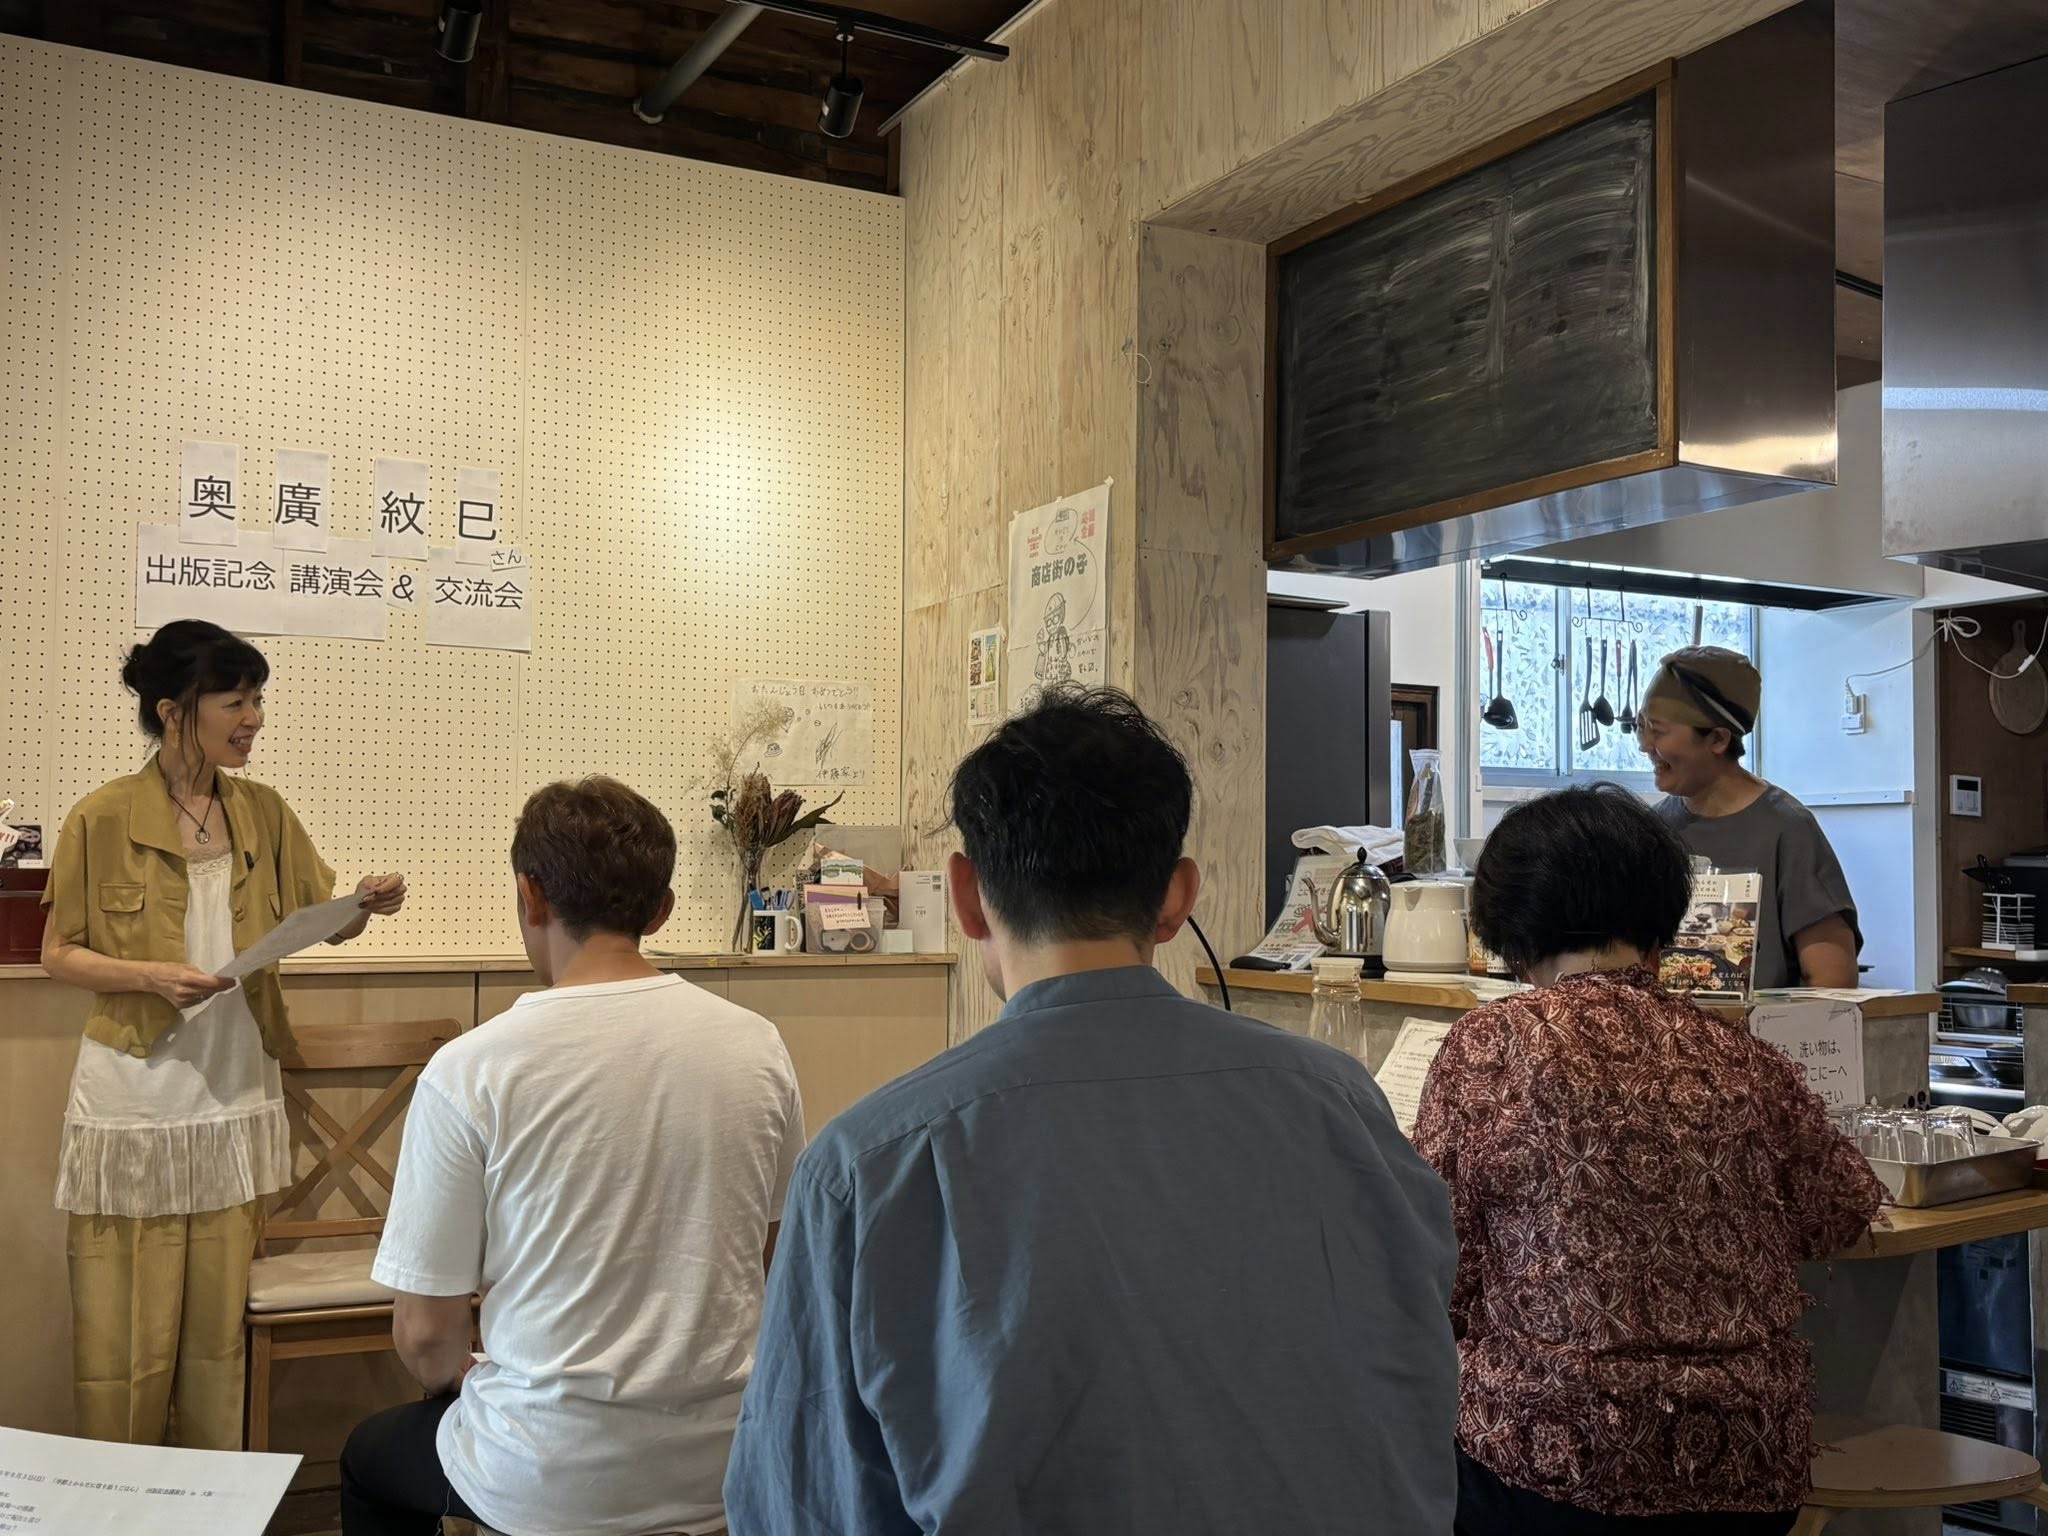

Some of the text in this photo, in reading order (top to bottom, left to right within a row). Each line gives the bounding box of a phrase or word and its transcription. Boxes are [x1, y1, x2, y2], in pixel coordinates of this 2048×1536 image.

[490, 549, 523, 567] さん
[1031, 553, 1088, 588] 商店街の子
[146, 555, 525, 610] 出版記念 講演会 & 交流会
[1799, 1040, 1841, 1058] 洗い物は、
